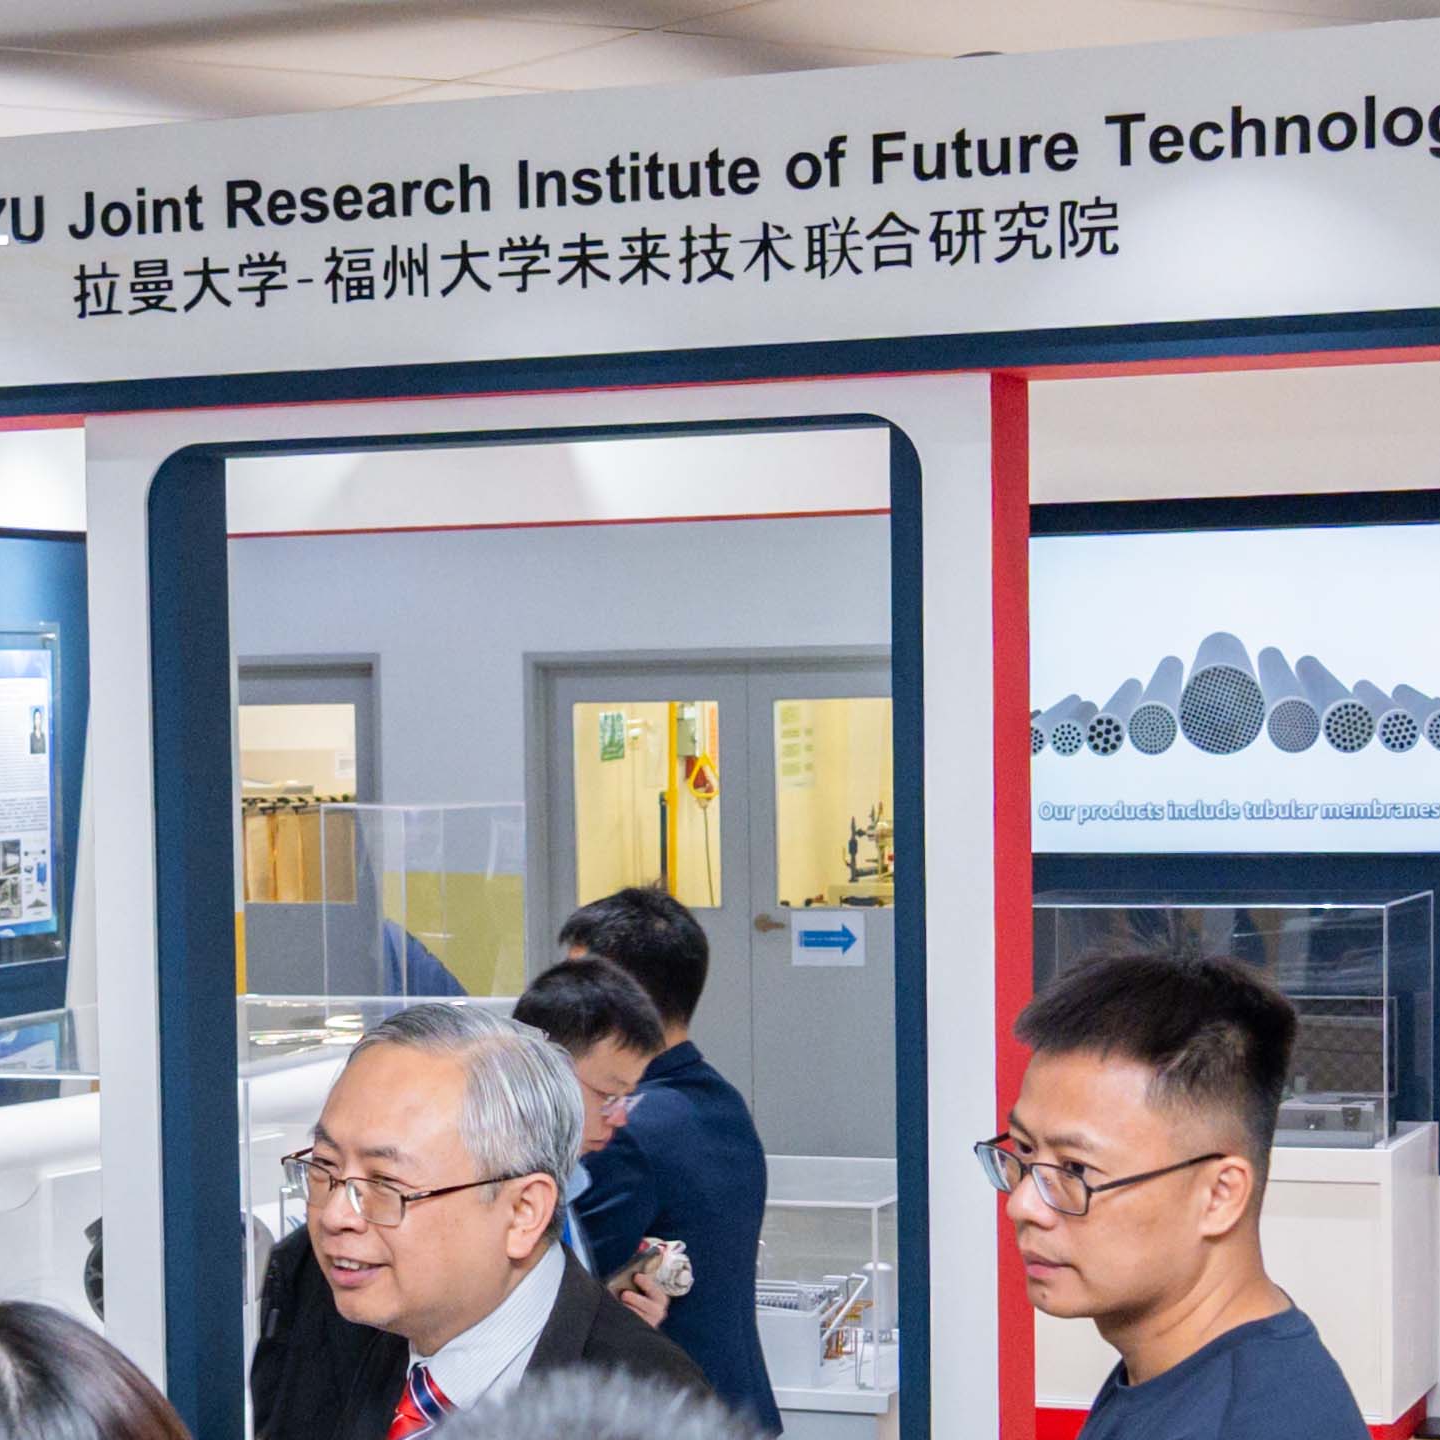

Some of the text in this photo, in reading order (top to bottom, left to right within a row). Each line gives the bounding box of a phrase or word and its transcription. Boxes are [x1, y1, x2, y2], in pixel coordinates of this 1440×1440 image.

[68, 184, 204, 240] Joint
[226, 163, 491, 229] Research
[518, 147, 760, 209] Institute
[785, 135, 848, 190] of
[872, 128, 1079, 185] Future
[73, 195, 1120, 319] 拉曼大学-福州大学未来技术联合研究院
[1038, 801, 1075, 820] Our
[1077, 800, 1163, 824] products
[1167, 799, 1241, 820] include
[1243, 798, 1319, 820] tubular
